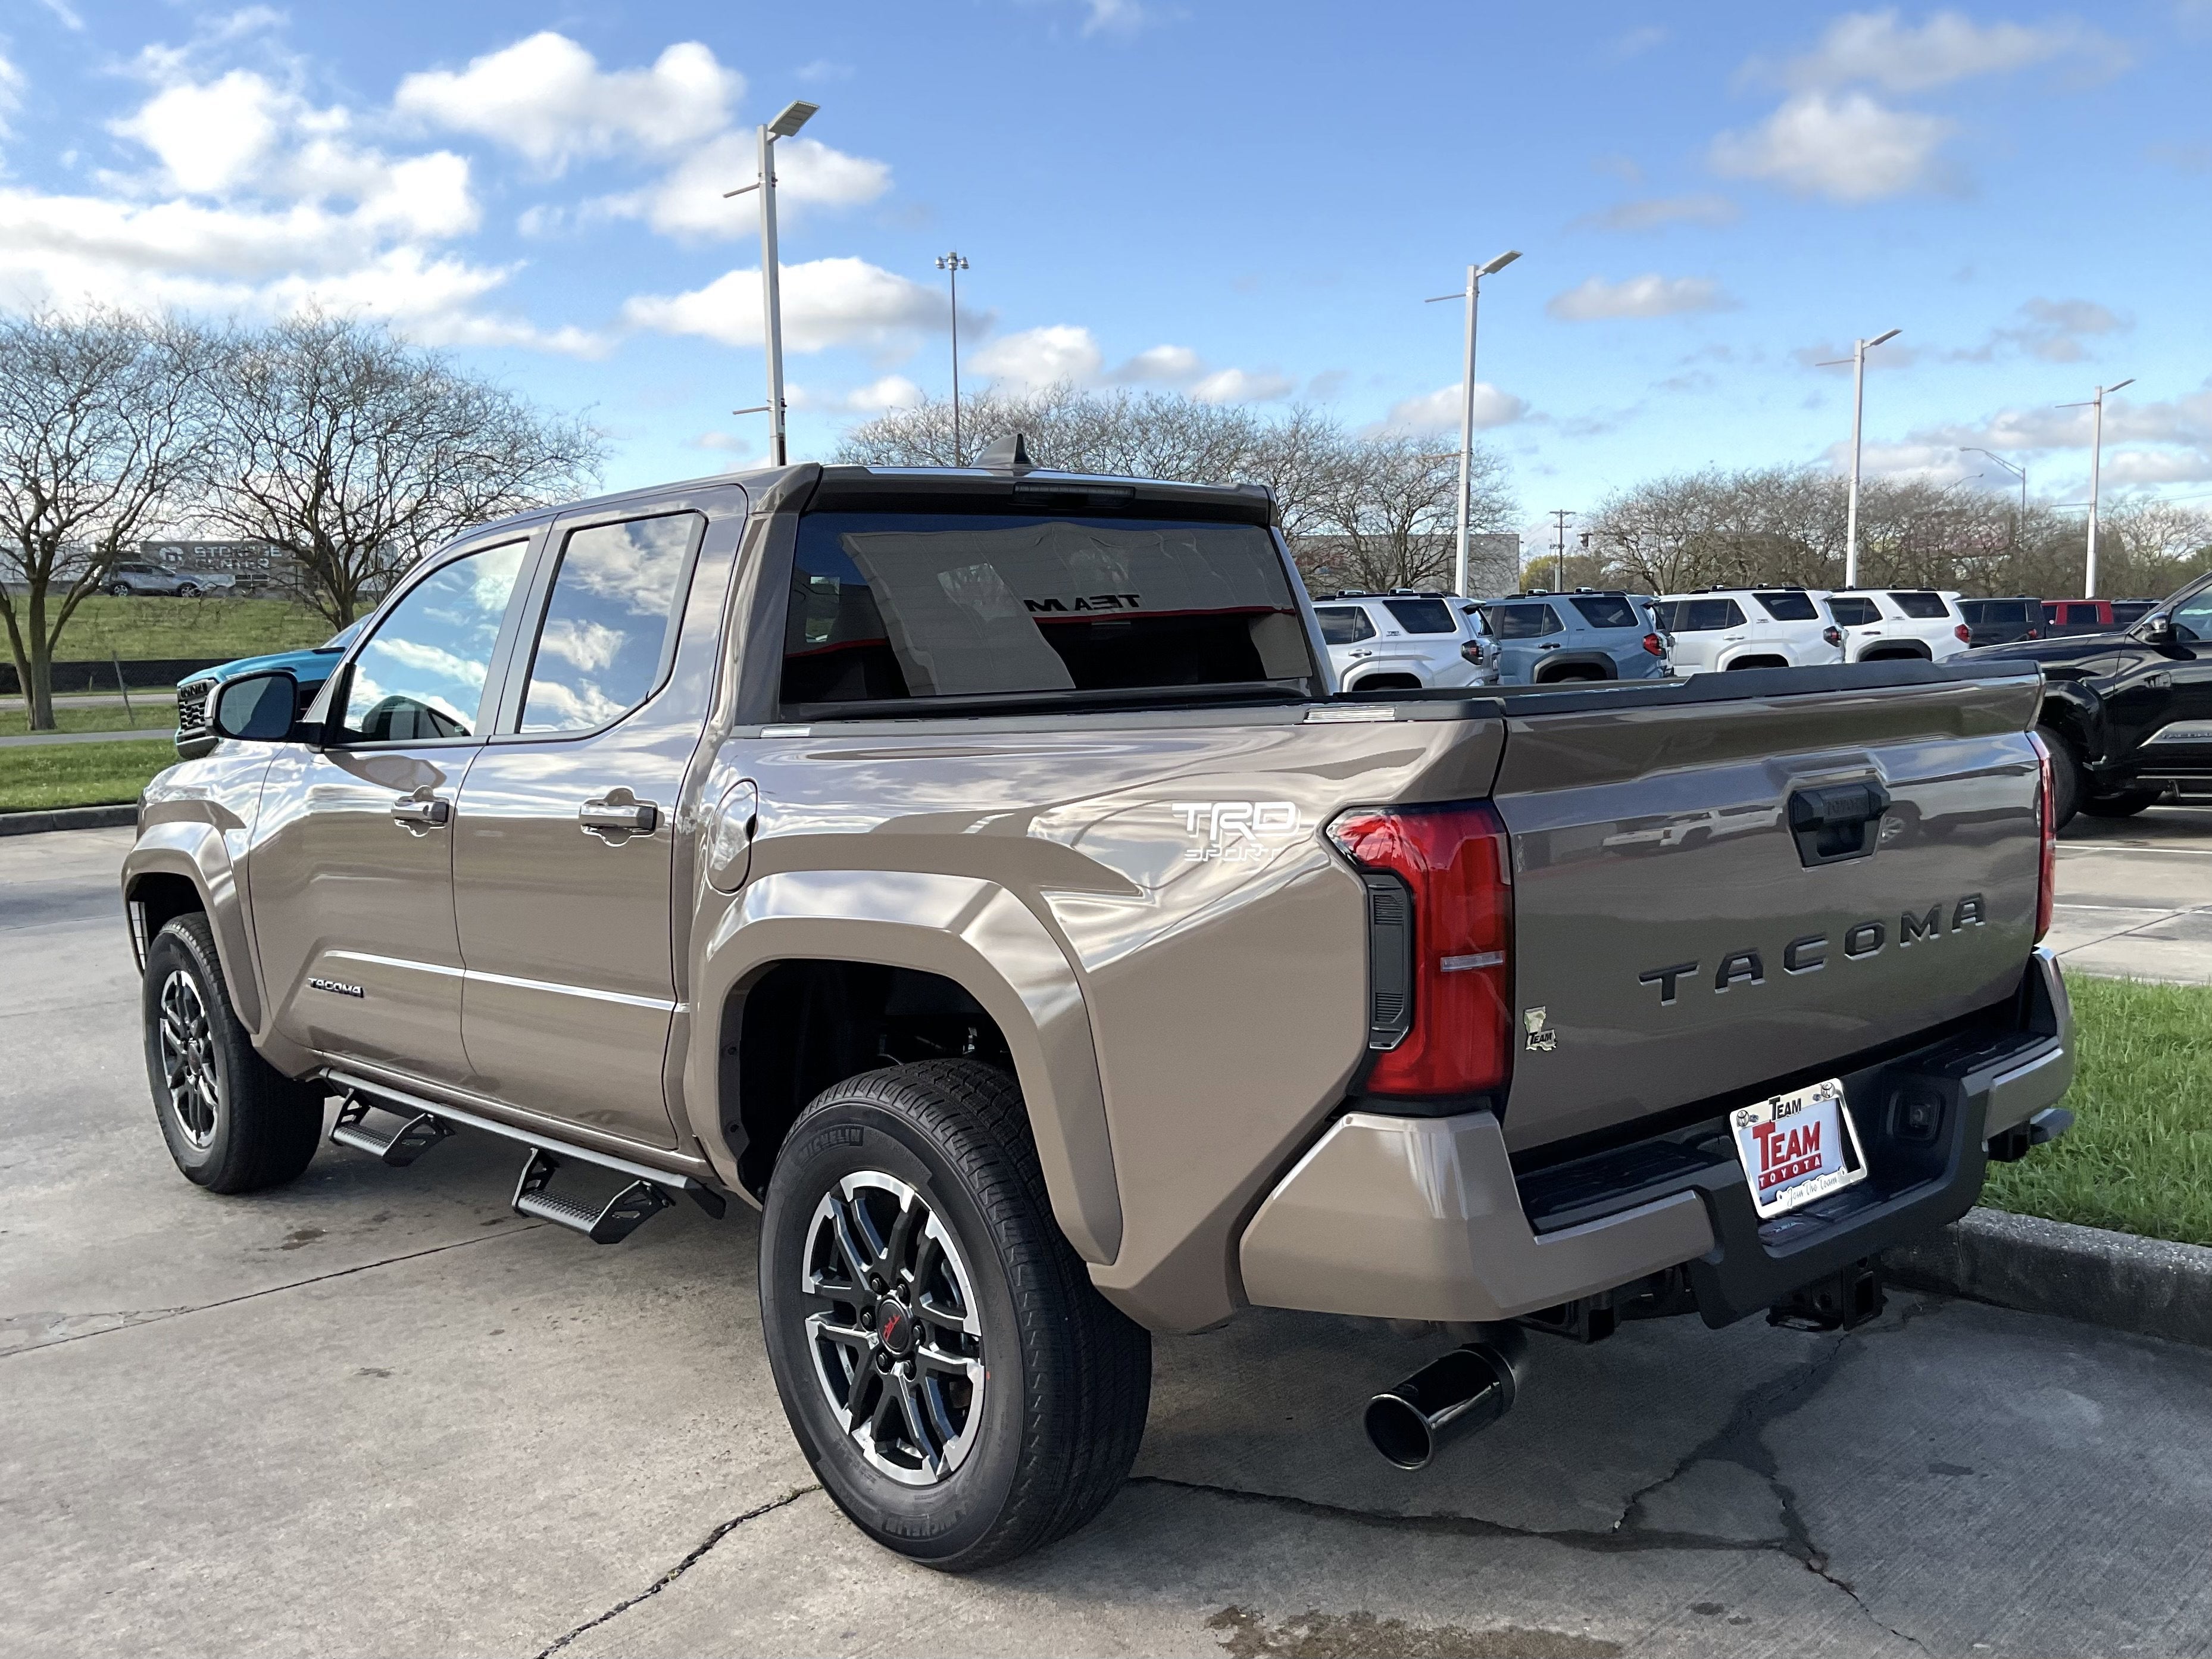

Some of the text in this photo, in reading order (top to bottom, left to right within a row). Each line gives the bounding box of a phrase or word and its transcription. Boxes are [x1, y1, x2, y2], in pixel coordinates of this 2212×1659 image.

[1827, 798, 1864, 816] TOYO
[1171, 801, 1298, 841] TRD
[1185, 847, 1283, 862] SPORT
[1638, 892, 1987, 1007] TACOMA
[308, 977, 364, 998] TACOMA
[1529, 1031, 1553, 1045] TEAM
[1769, 1097, 1801, 1121] TEAM
[1752, 1120, 1820, 1172] TEAM
[1759, 1157, 1820, 1188] TOYOTA
[1788, 1188, 1803, 1207] Join
[1803, 1181, 1818, 1195] The
